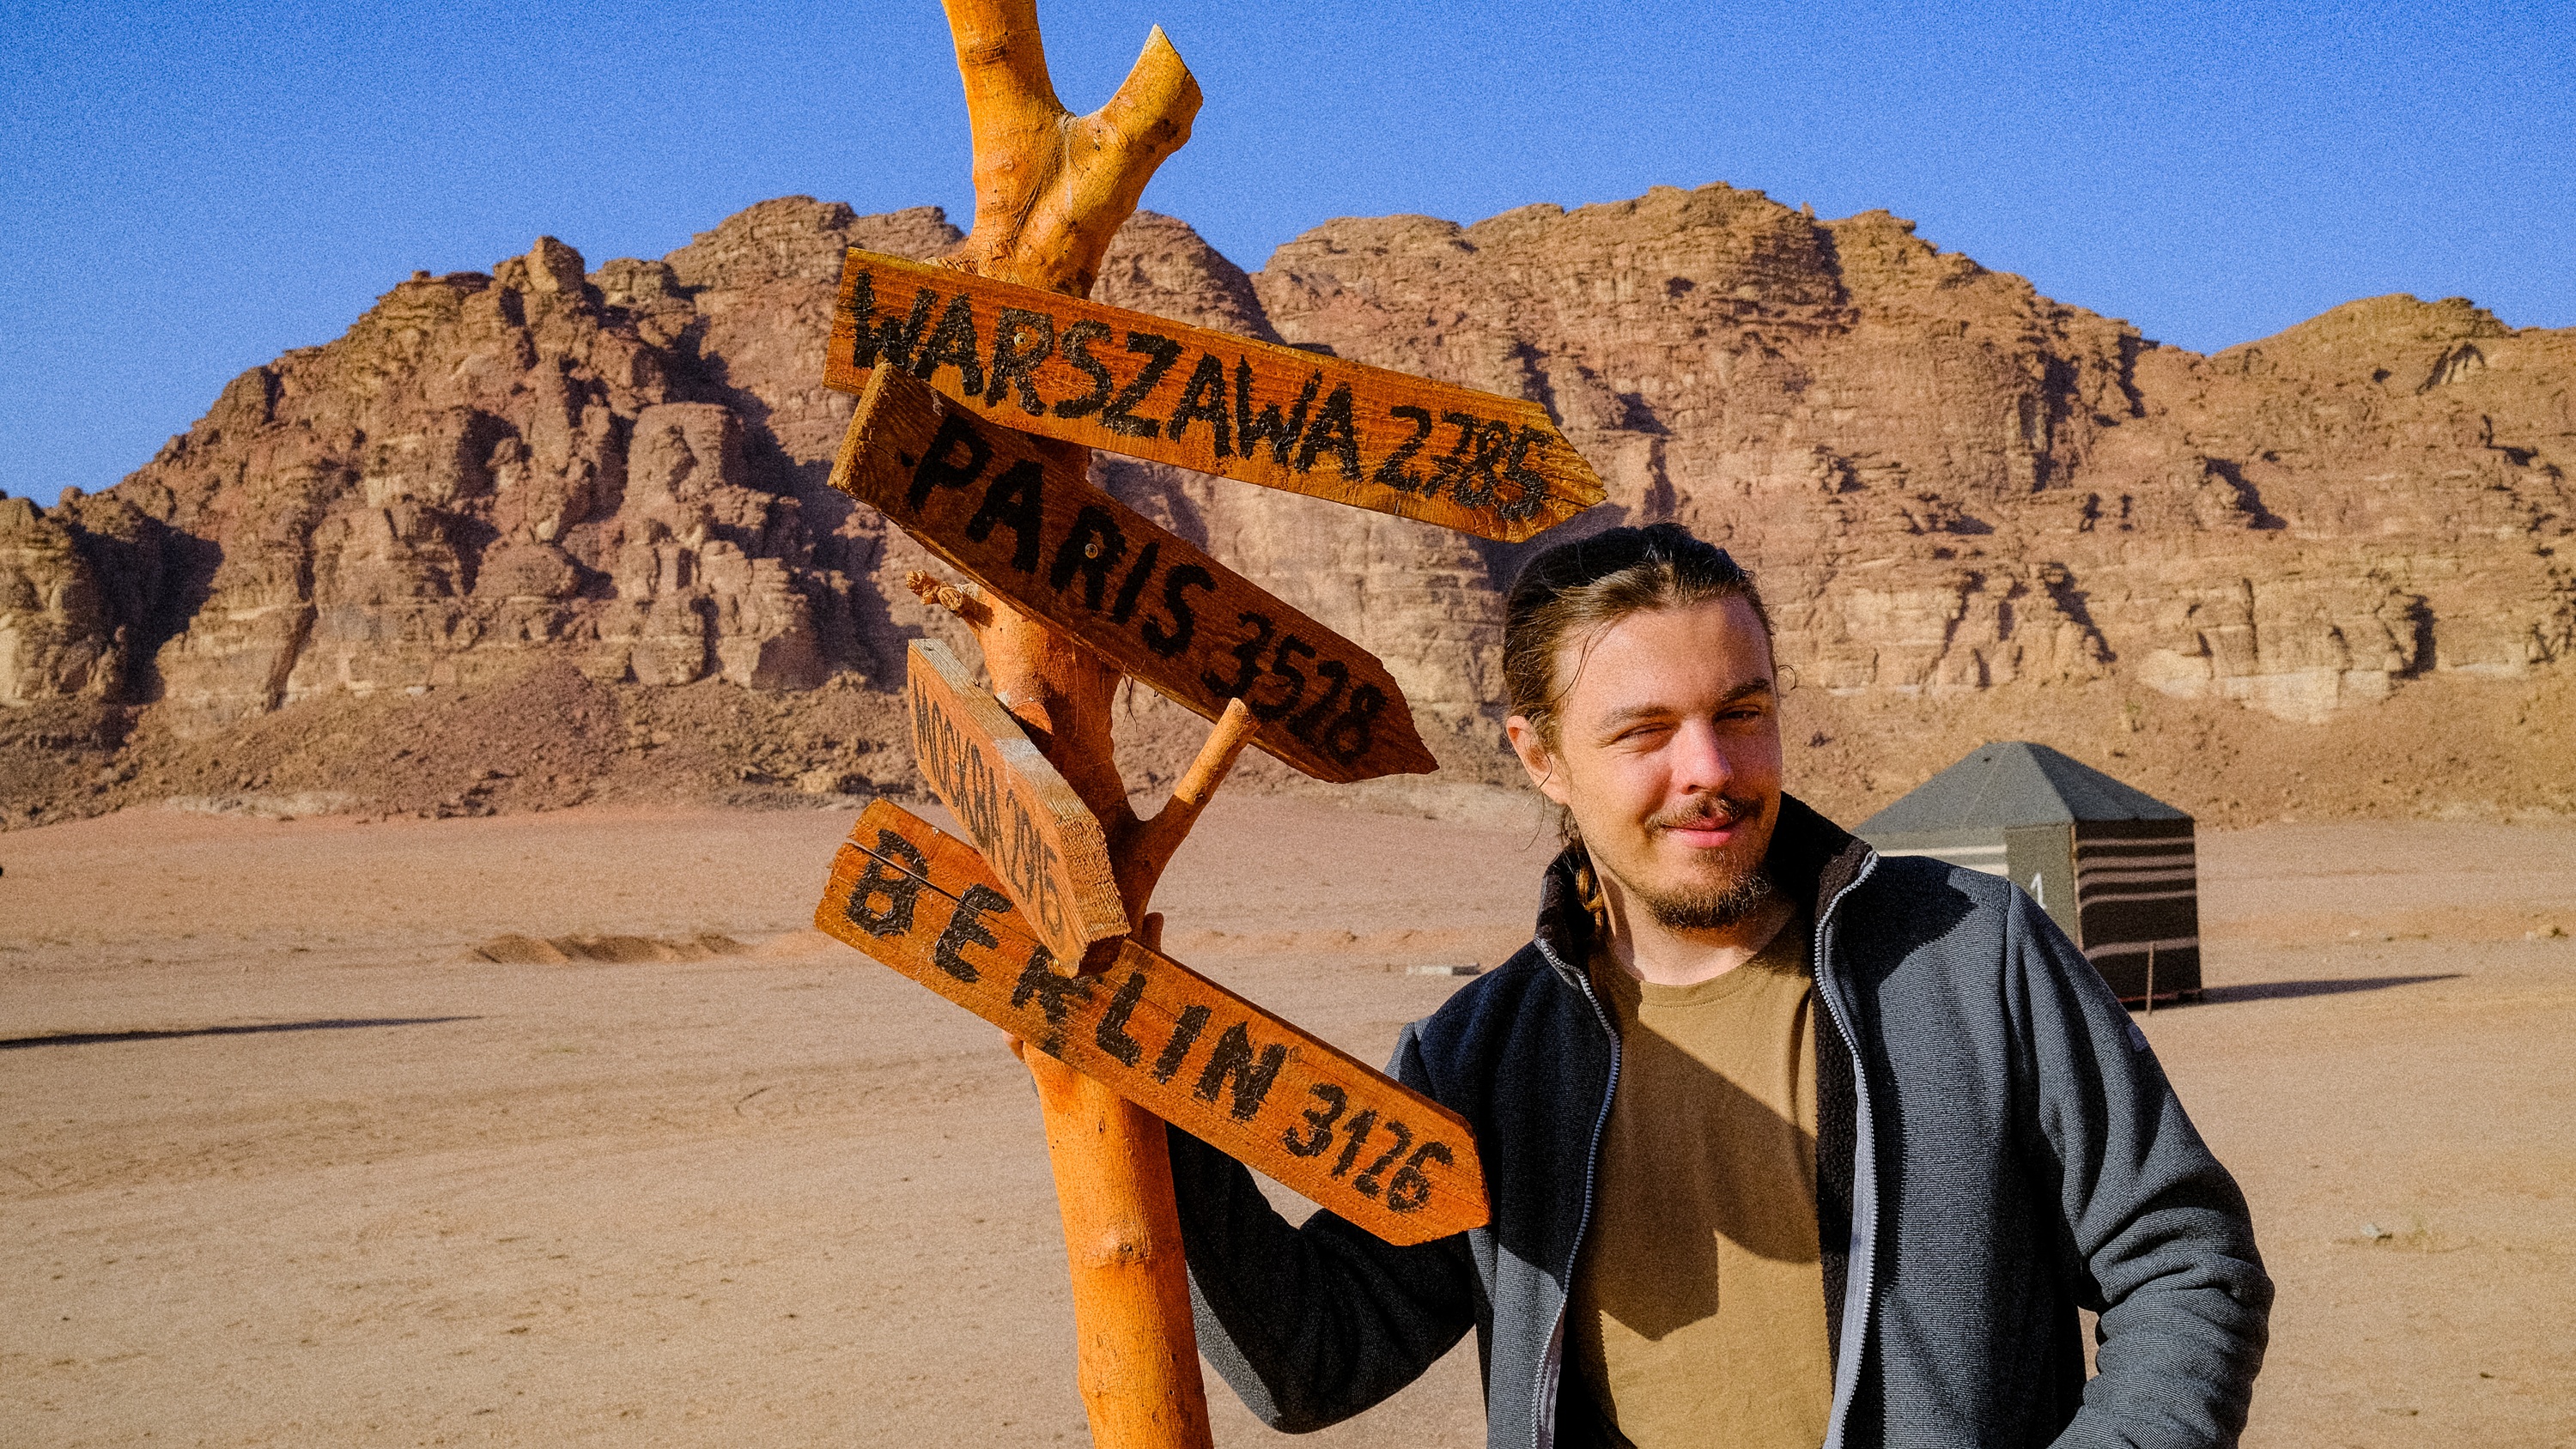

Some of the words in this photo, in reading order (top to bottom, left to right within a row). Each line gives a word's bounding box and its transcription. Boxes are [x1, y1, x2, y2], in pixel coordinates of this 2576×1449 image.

[853, 270, 1362, 482] WARSZAWA
[1373, 405, 1553, 521] 2785
[907, 413, 1218, 658] PARIS
[1203, 611, 1388, 765] 3528
[1285, 1083, 1454, 1213] 3126
